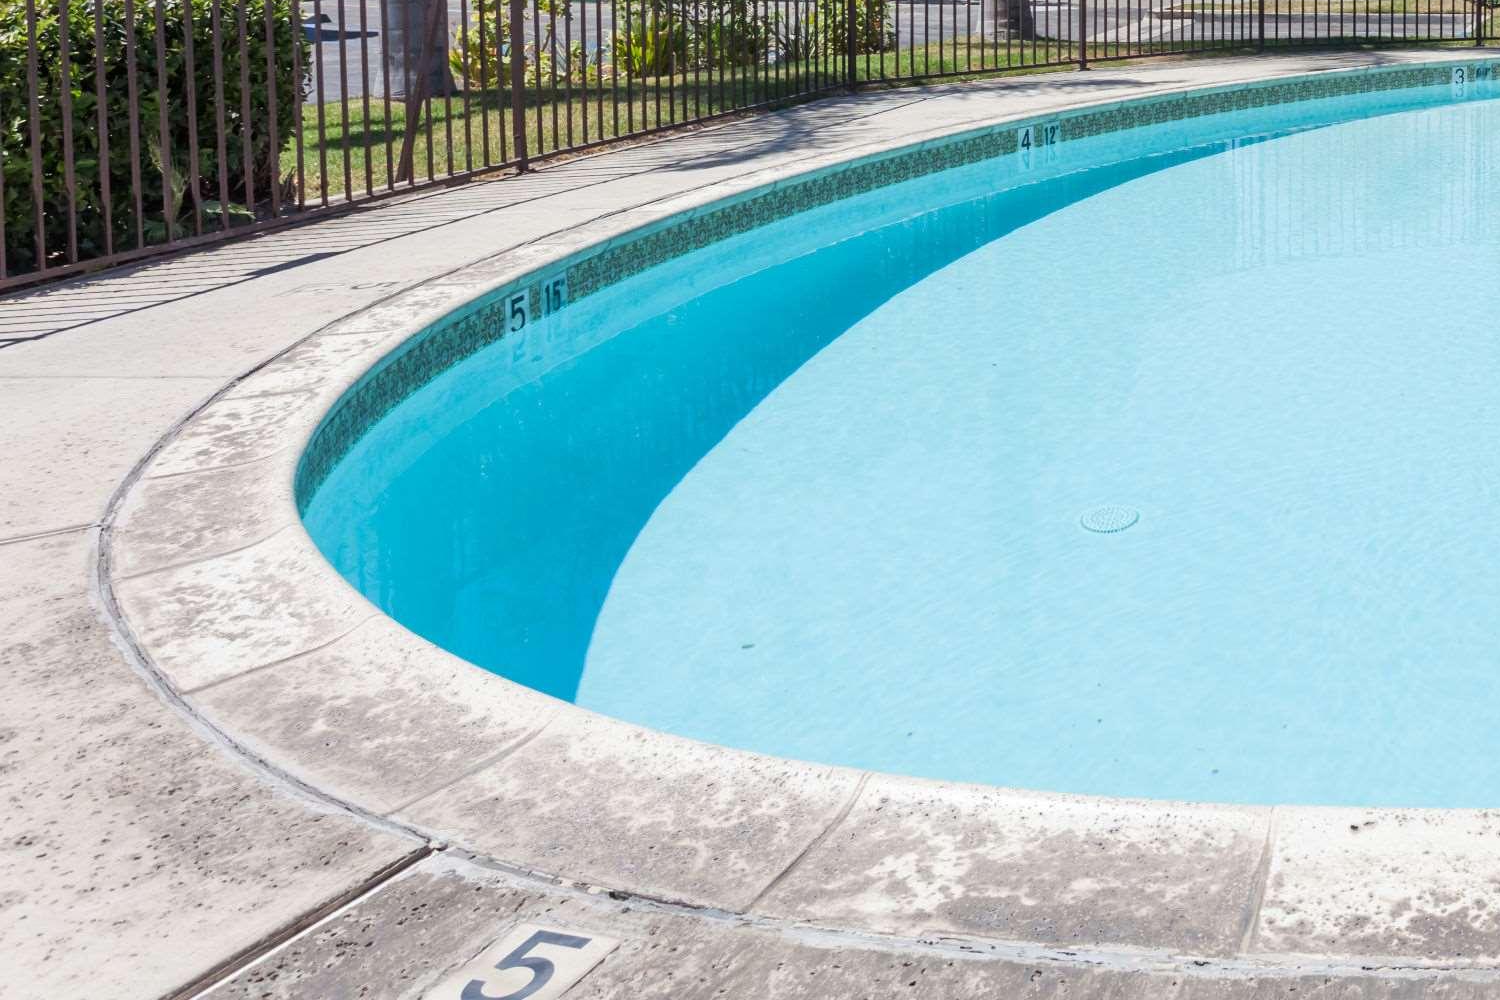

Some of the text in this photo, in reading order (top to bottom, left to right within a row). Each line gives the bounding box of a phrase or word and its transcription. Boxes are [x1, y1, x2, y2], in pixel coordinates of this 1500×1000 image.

[1455, 68, 1465, 84] 3
[1021, 128, 1031, 150] 4
[511, 294, 526, 332] 5
[460, 929, 593, 1000] 5
